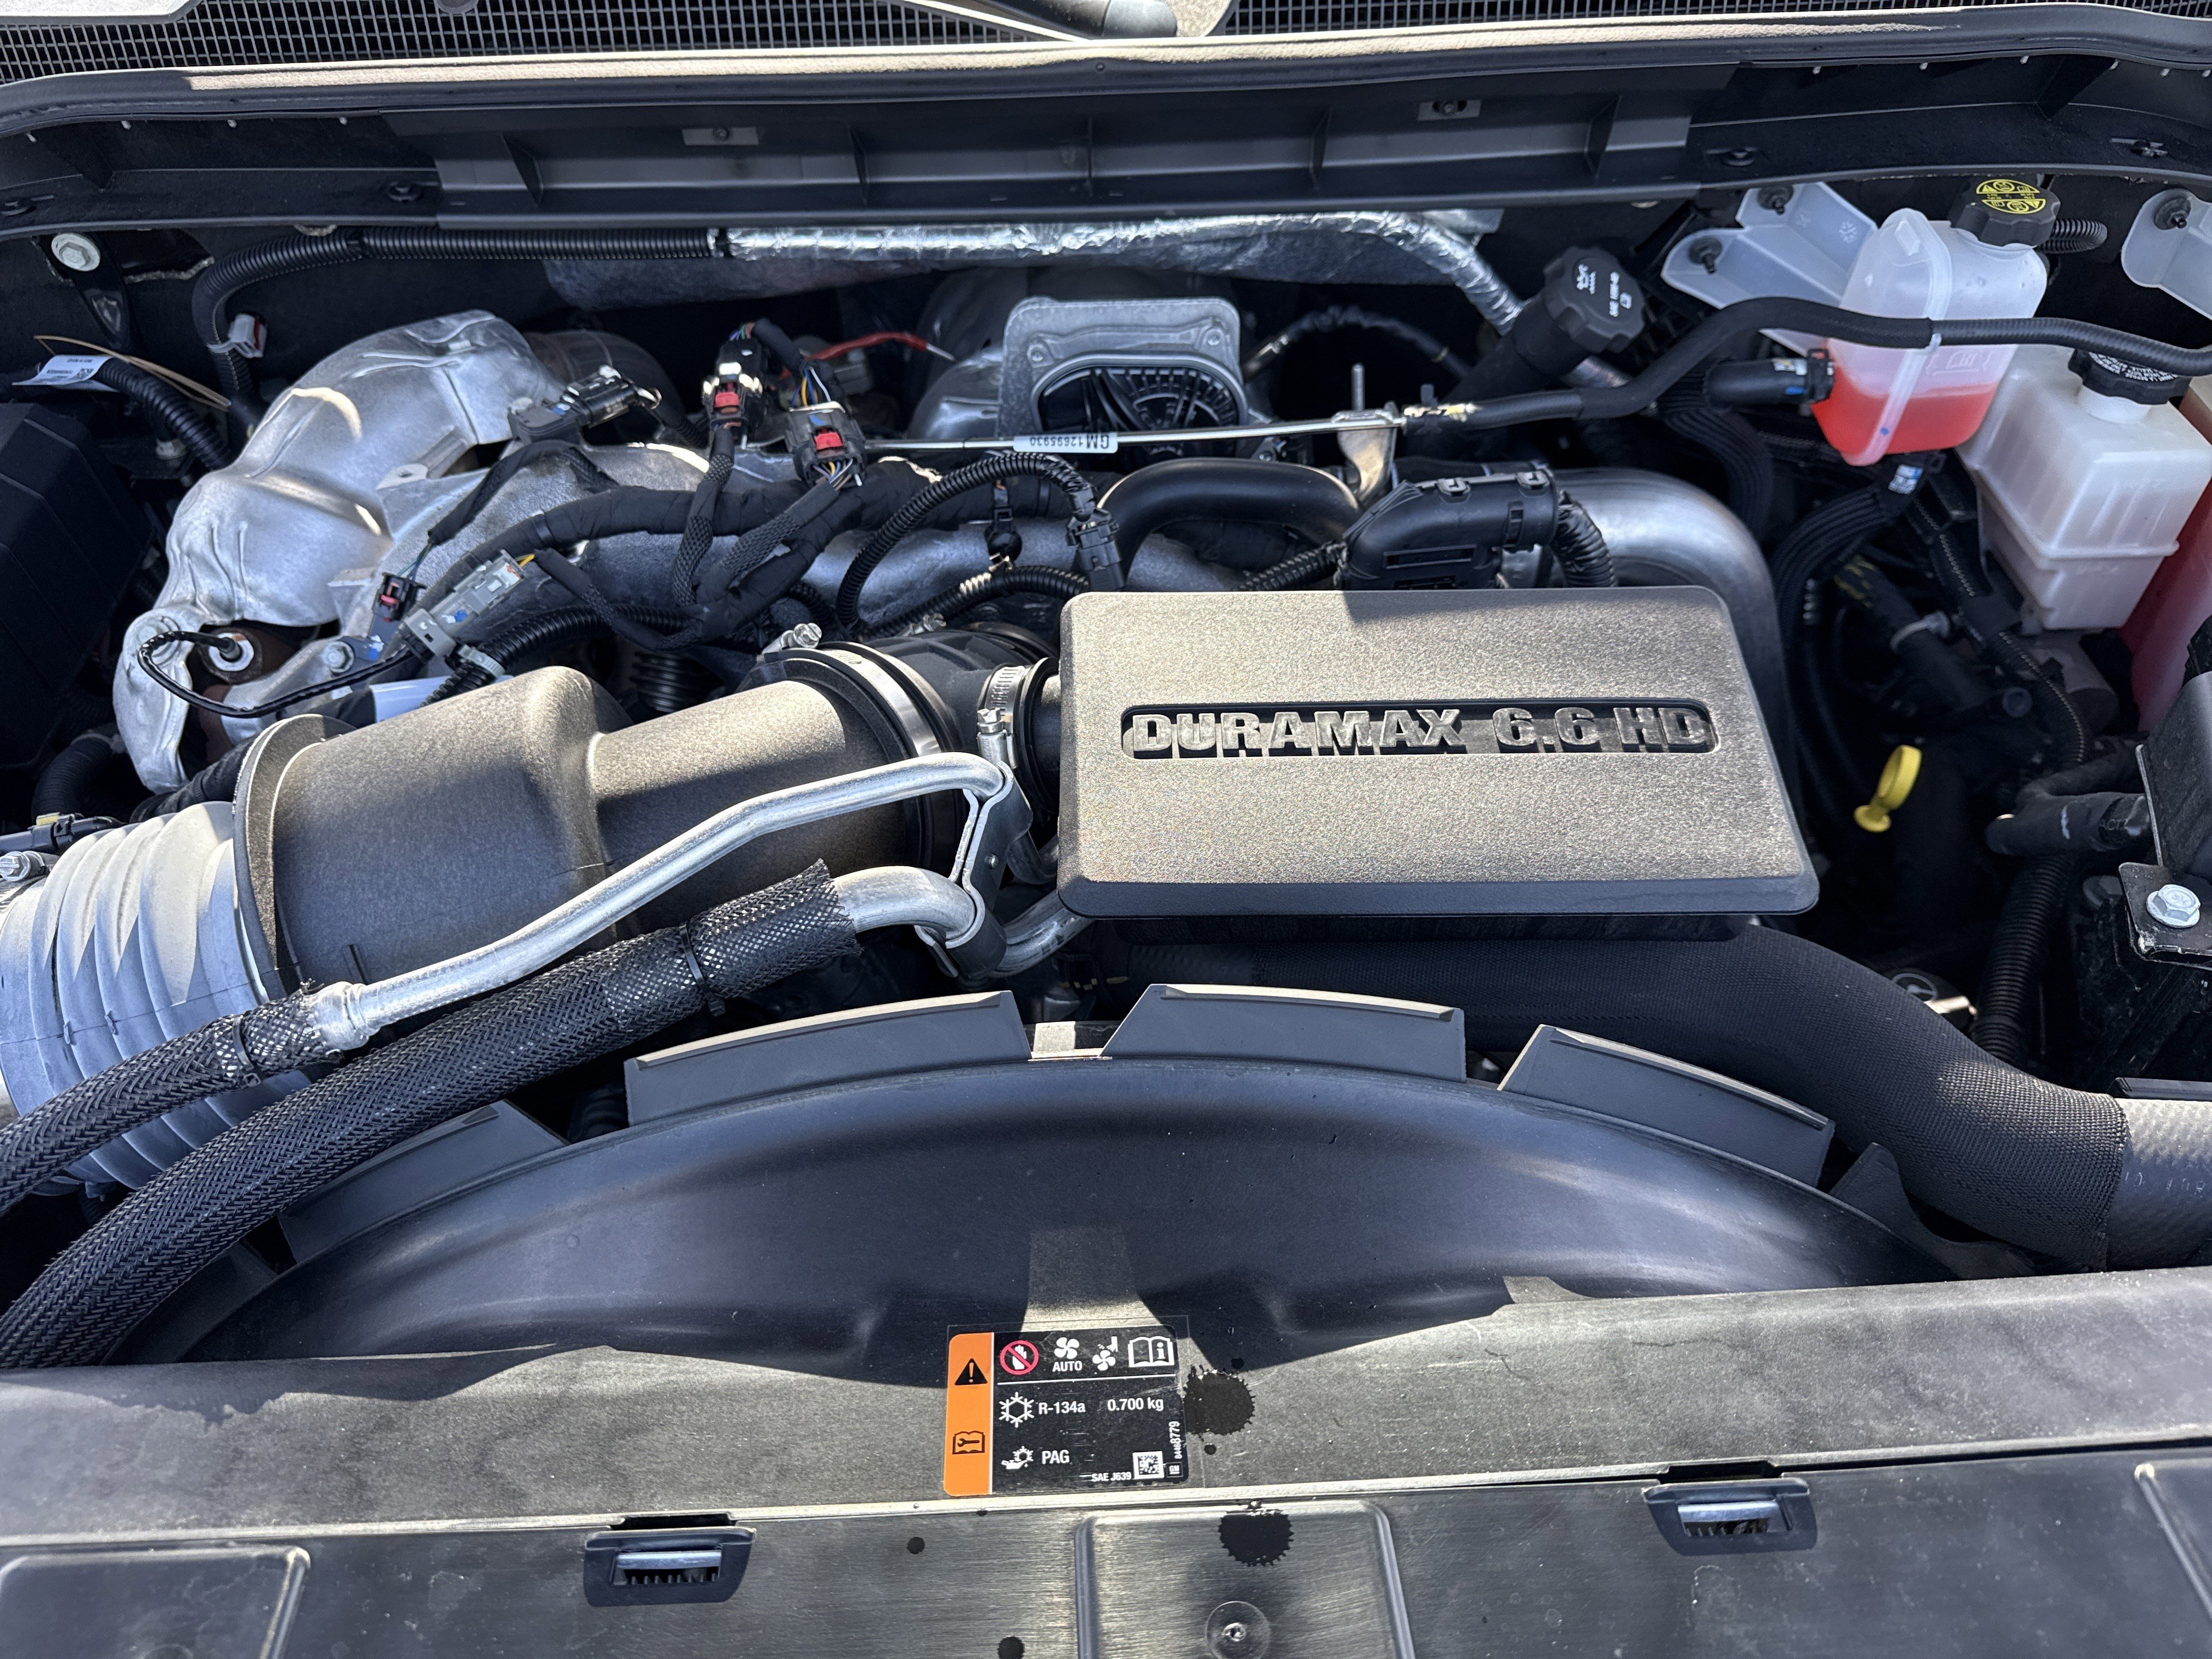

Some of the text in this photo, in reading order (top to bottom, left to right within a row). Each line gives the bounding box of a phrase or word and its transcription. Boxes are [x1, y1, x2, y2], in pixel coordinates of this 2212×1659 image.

[1030, 435, 1109, 449] GM 12695930
[1132, 707, 1708, 751] DURAMAX 6.6 HD
[1052, 1361, 1082, 1372] AUTO
[1038, 1397, 1164, 1415] R-134a 0.700 kg
[1168, 1421, 1183, 1459] 84468779
[1042, 1450, 1070, 1464] PAG
[1091, 1472, 1132, 1482] SAE J639
